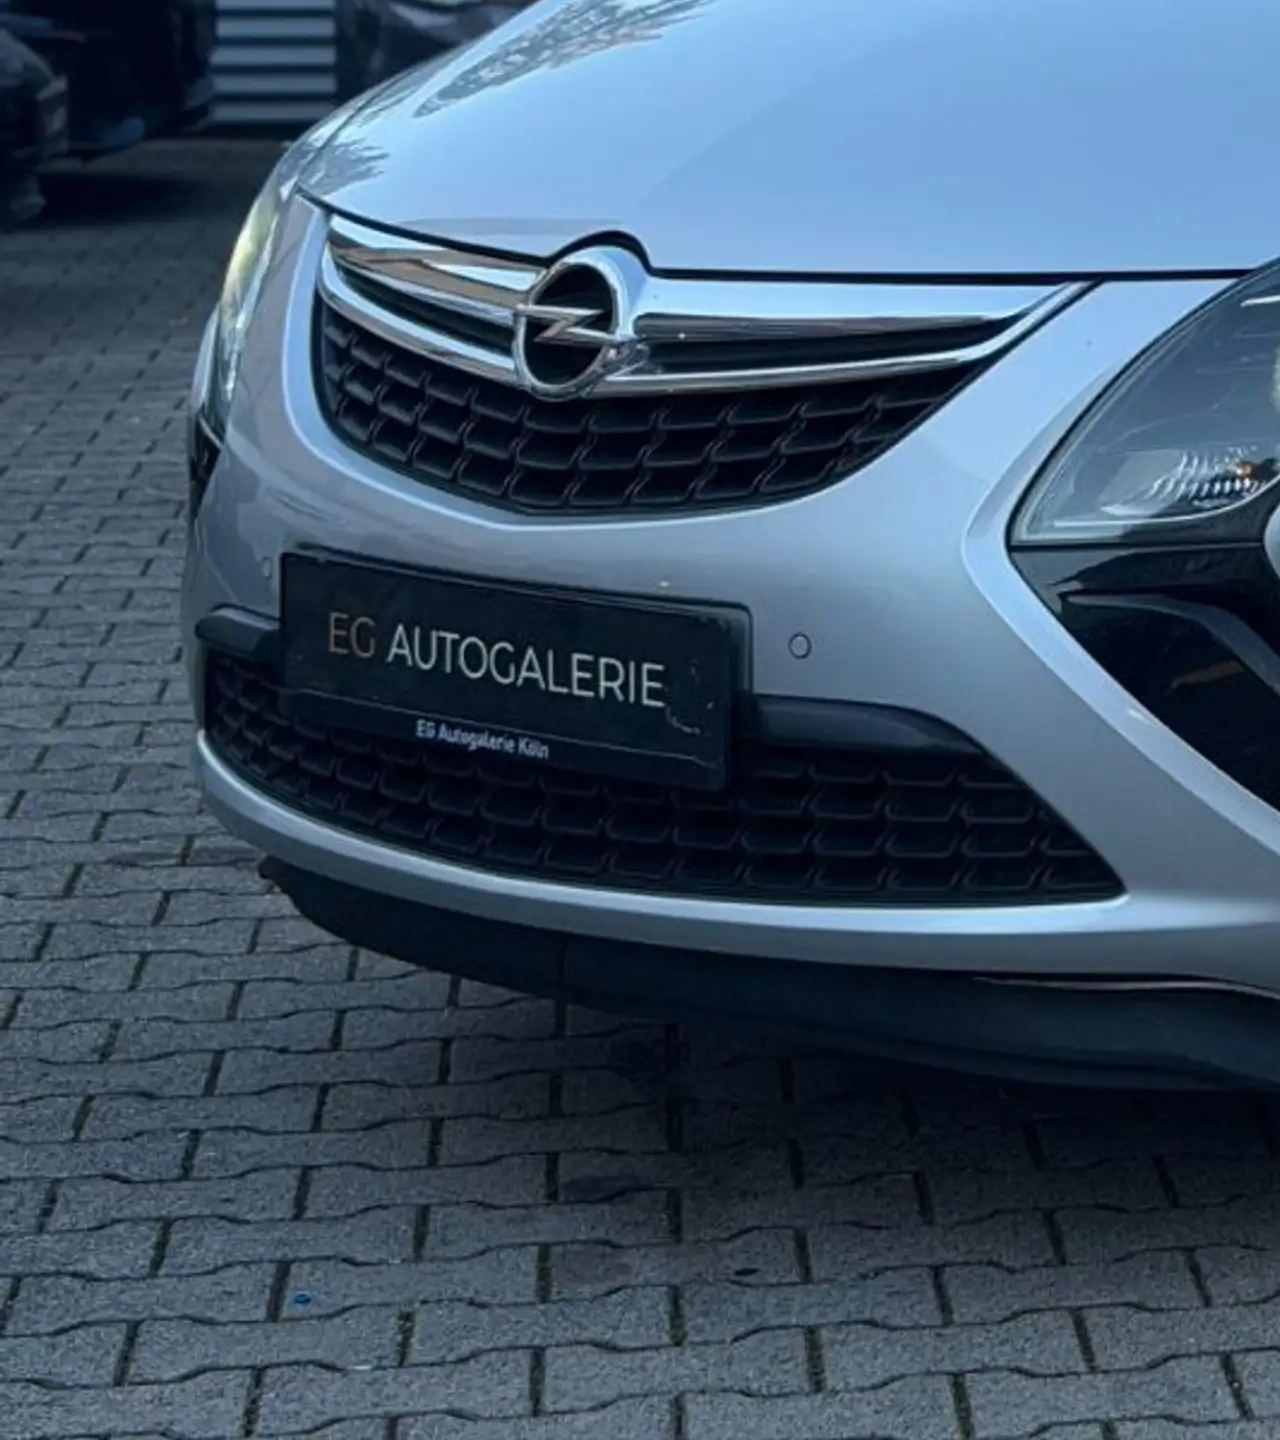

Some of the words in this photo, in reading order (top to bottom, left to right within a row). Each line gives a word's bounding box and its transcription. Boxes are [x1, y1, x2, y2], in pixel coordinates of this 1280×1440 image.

[328, 611, 377, 659] EG
[386, 623, 666, 708] AUTOGALERIE
[415, 718, 437, 738] EG
[438, 722, 516, 753] Autogalerie
